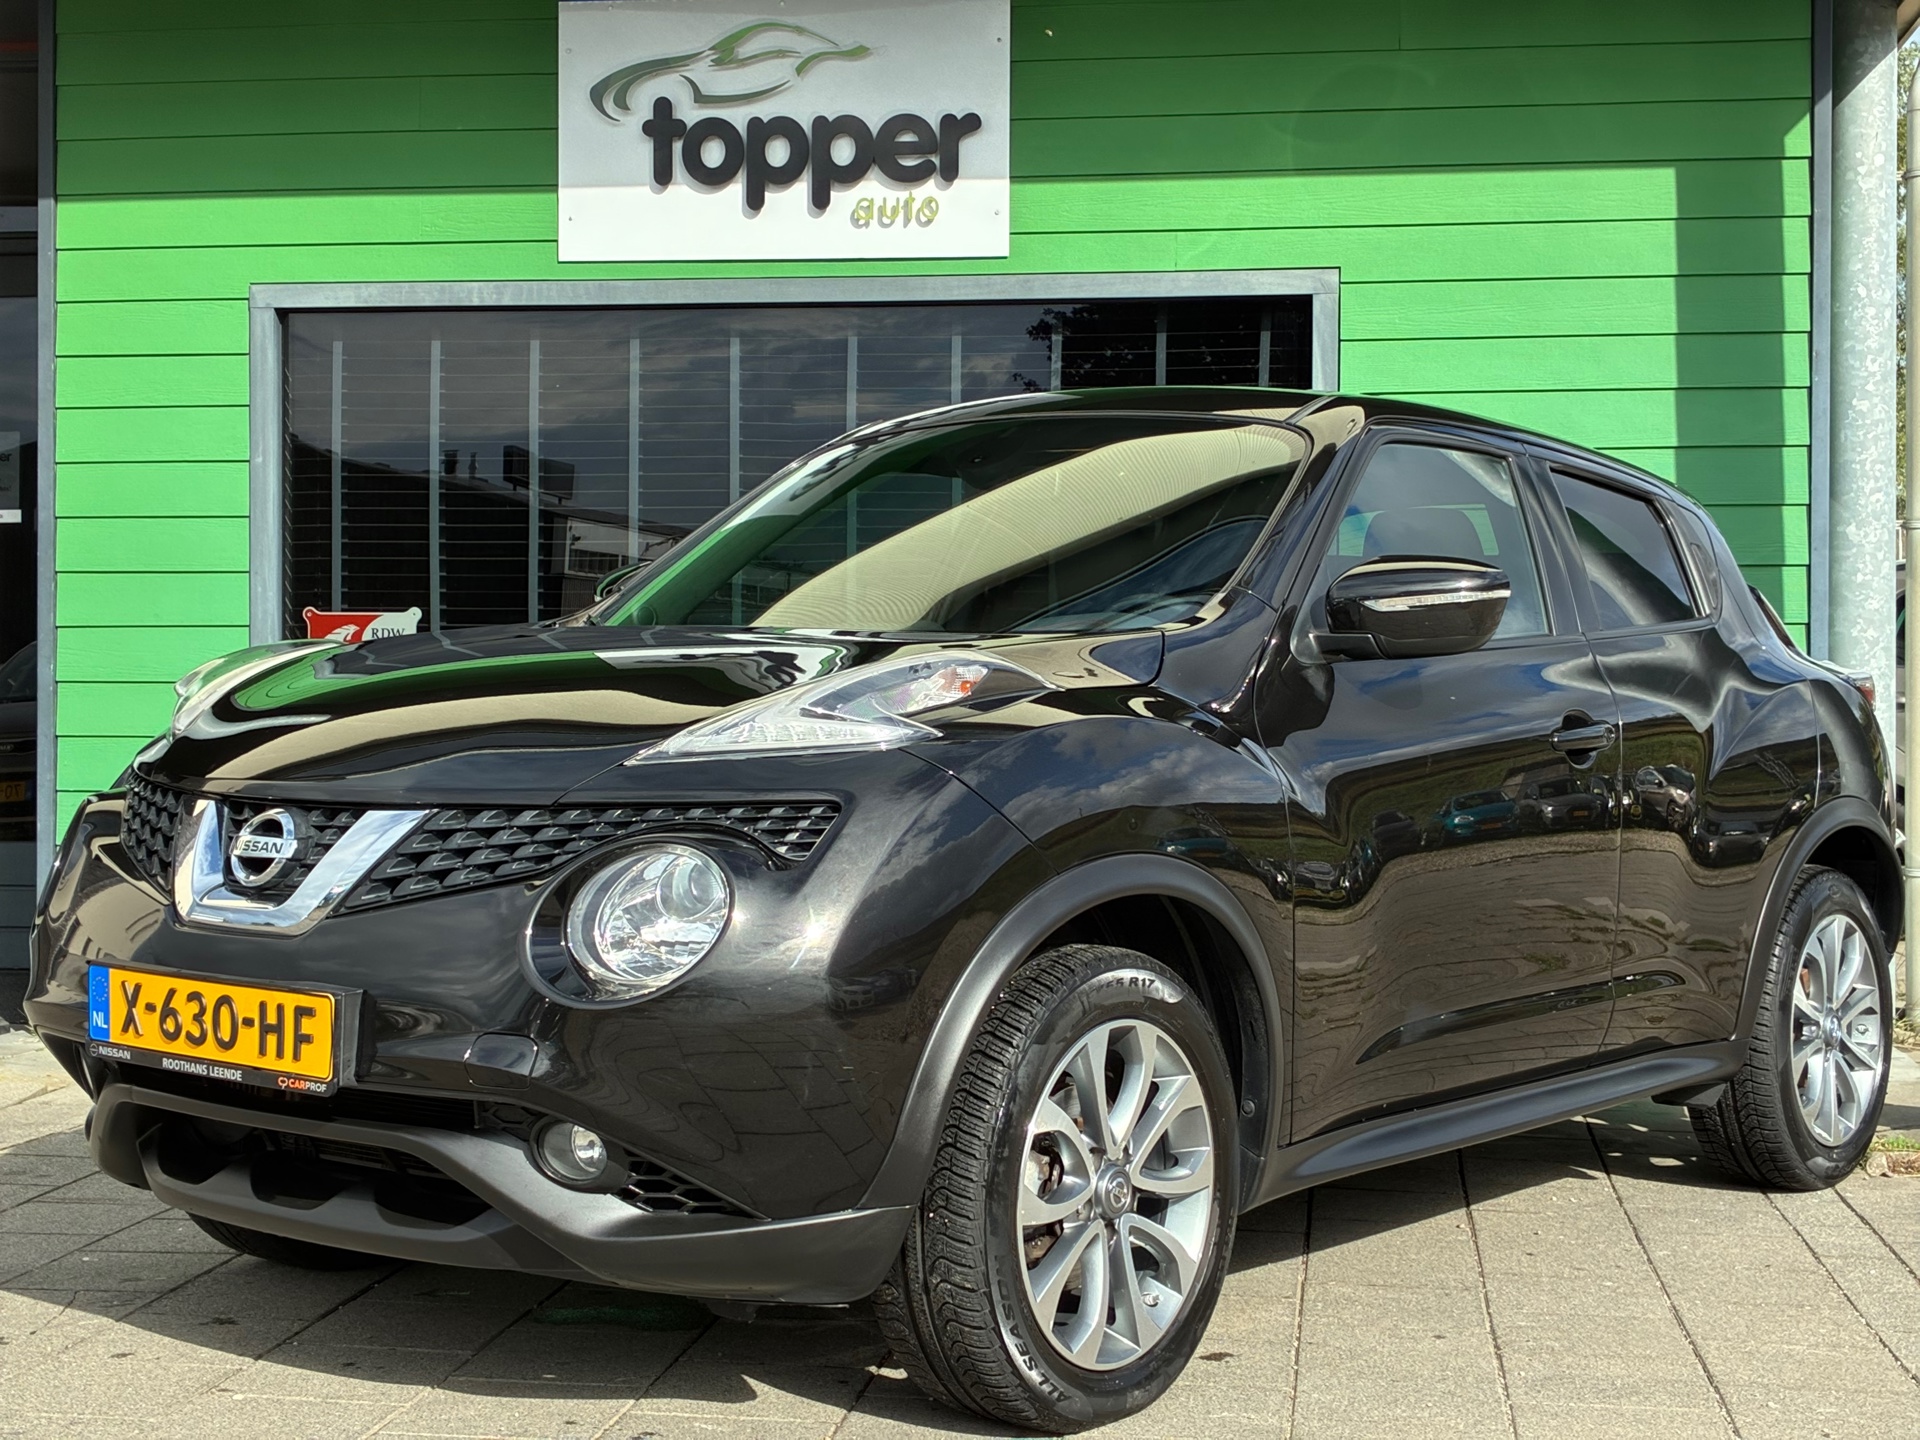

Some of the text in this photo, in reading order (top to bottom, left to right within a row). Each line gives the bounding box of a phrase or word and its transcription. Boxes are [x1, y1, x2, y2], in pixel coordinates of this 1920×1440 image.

[641, 96, 982, 211] topper
[853, 191, 939, 222] auto
[371, 627, 405, 639] RDW
[1128, 976, 1156, 989] R17
[92, 1010, 108, 1029] NL
[120, 980, 316, 1062] X-630-HF
[99, 1045, 131, 1060] NISSAN
[162, 1058, 243, 1081] ROOTHANS LEENDE
[288, 1078, 328, 1093] CARPROF
[1038, 1371, 1072, 1403] ALL
